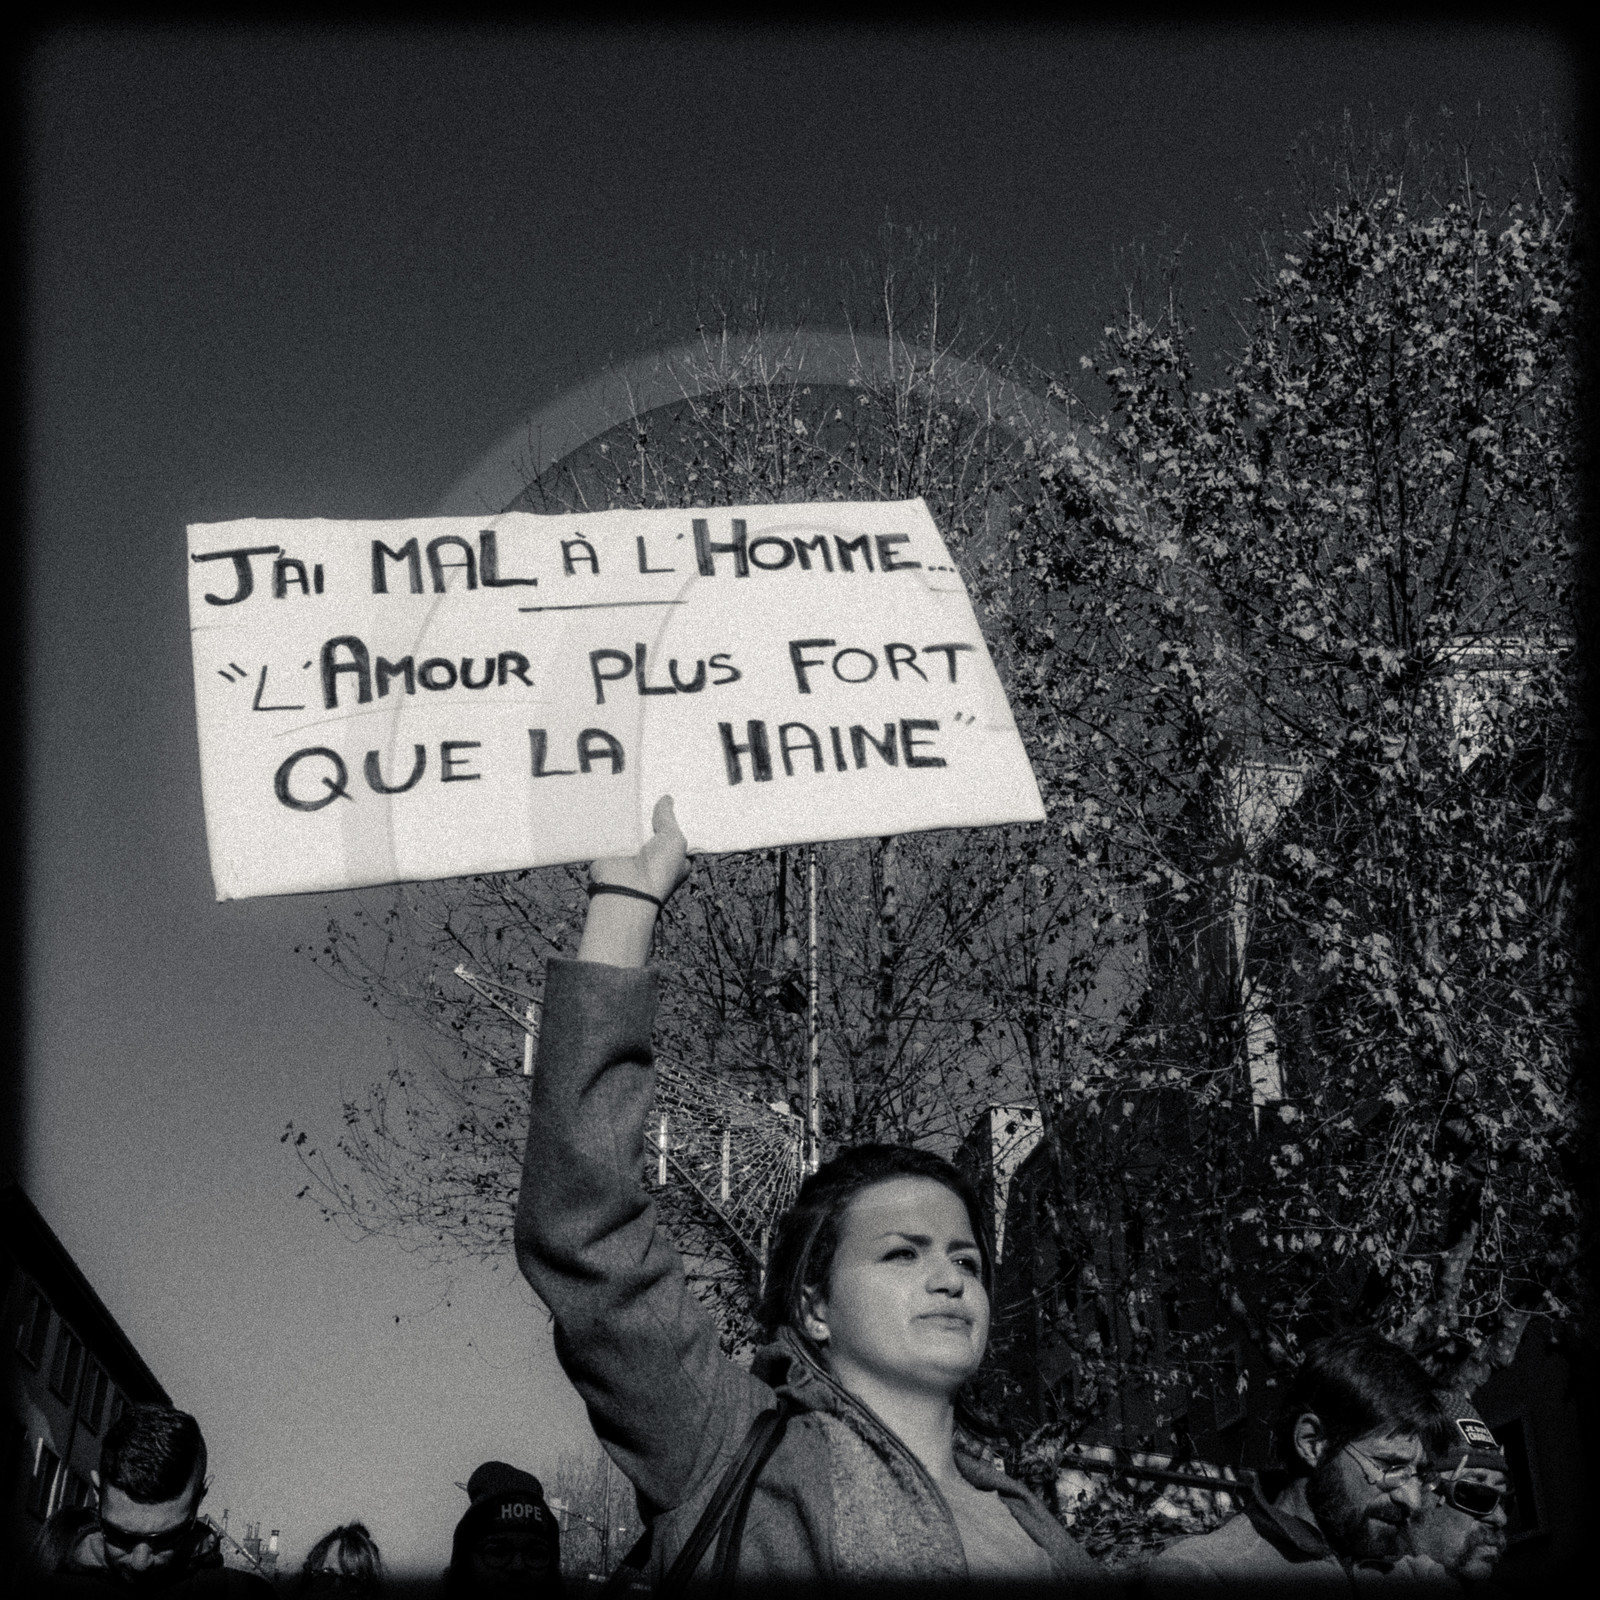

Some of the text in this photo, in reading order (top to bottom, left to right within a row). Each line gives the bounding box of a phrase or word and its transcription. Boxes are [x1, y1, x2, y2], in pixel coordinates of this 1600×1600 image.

[371, 530, 538, 594] MAL
[561, 532, 600, 577] À
[589, 642, 742, 705] PLUS
[788, 638, 974, 694] FORT
[274, 740, 482, 813] QUE
[528, 728, 626, 778] LA
[501, 1503, 543, 1521] HOPE
